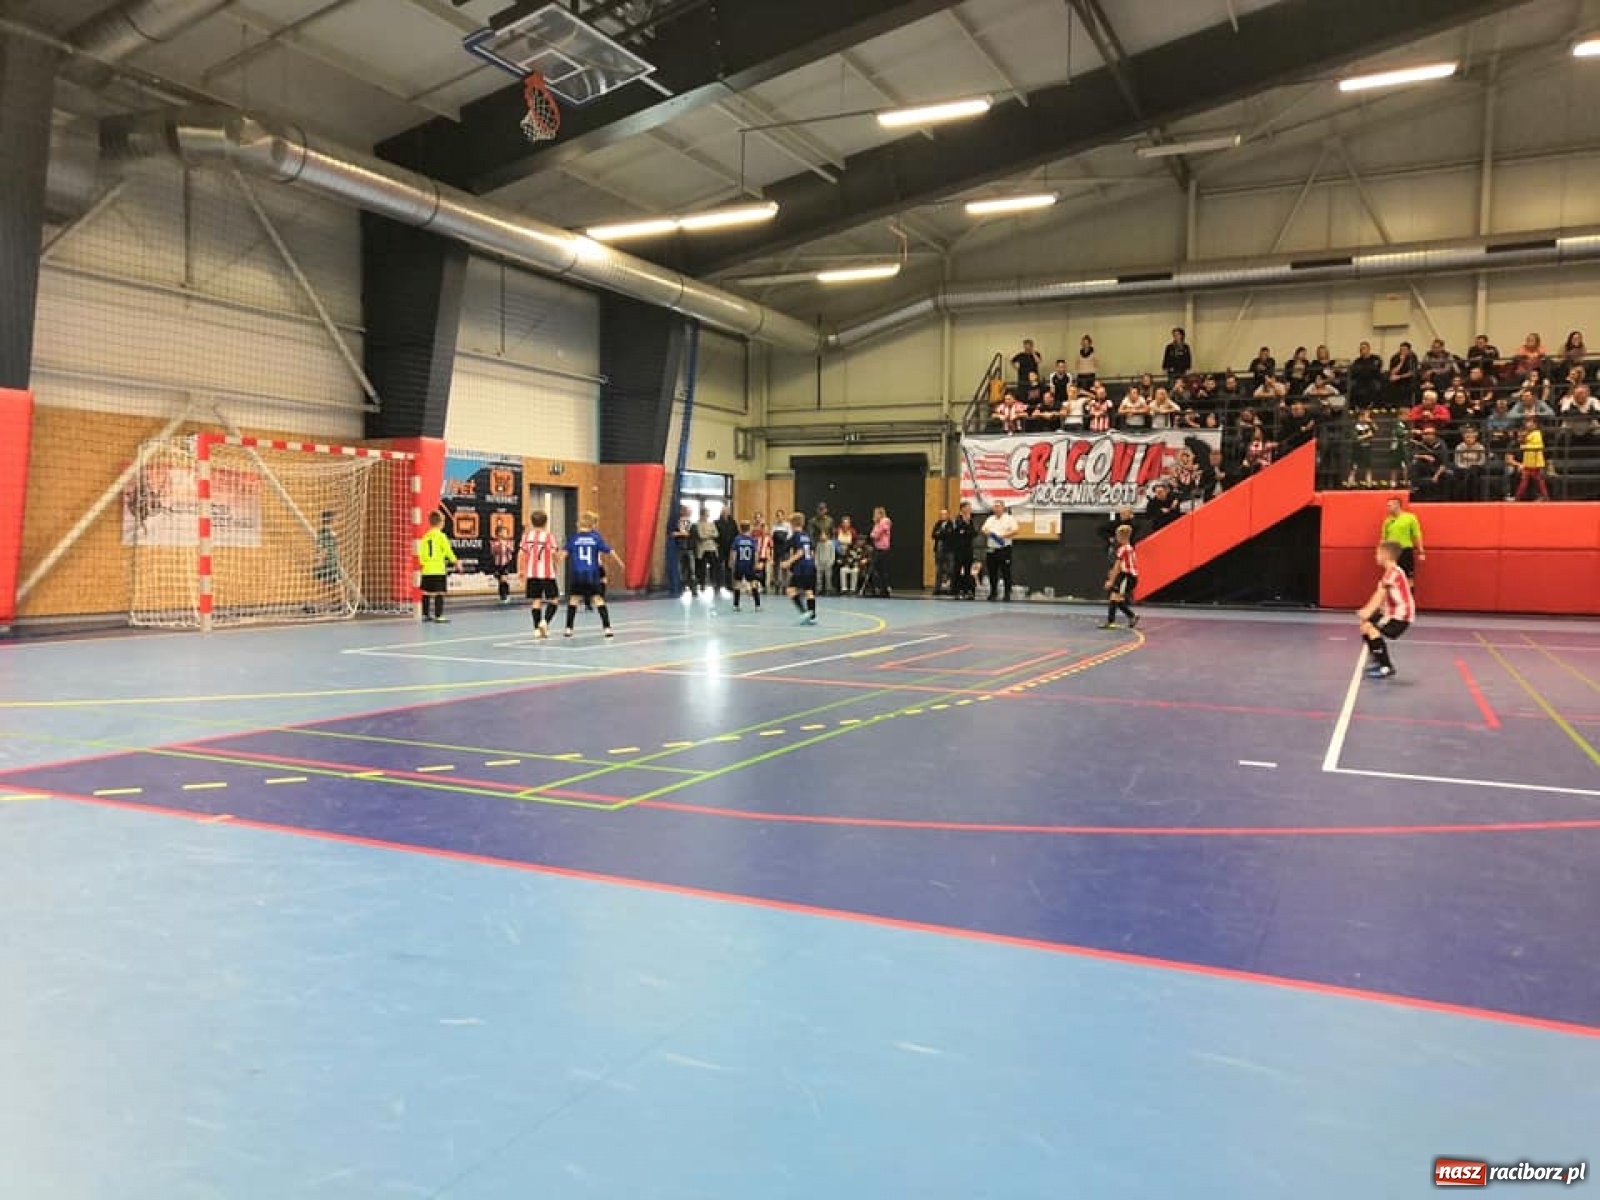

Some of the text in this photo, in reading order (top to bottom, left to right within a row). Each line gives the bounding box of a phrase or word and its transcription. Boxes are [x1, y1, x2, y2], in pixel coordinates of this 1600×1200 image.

[1009, 436, 1166, 490] CRACOVIA
[427, 539, 434, 558] 1
[578, 545, 592, 566] 4
[738, 545, 752, 561] 10
